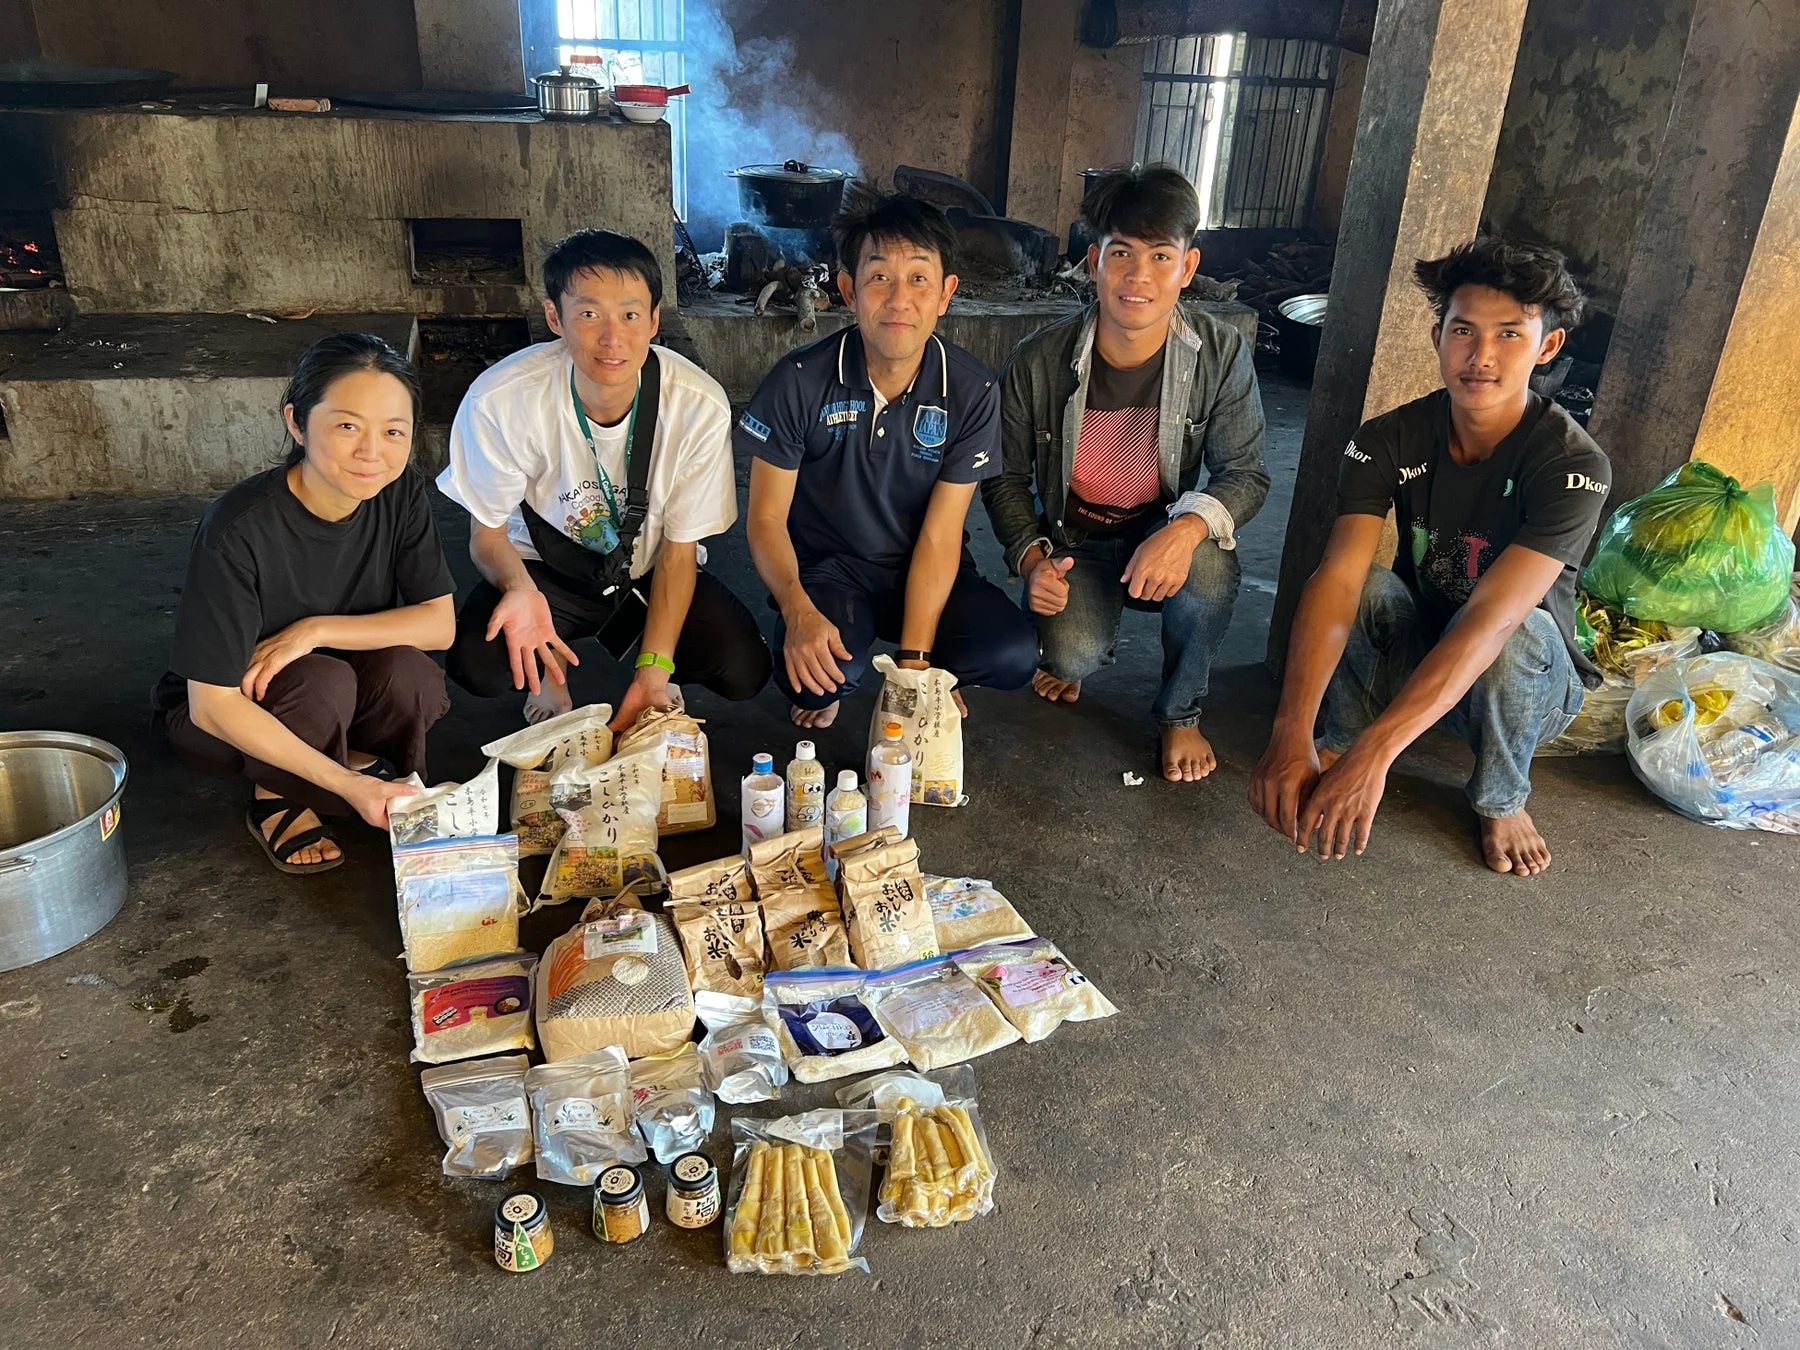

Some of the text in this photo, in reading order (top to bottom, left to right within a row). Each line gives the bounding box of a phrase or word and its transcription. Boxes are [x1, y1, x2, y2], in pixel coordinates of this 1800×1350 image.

[1344, 440, 1372, 463] Dkor
[1565, 473, 1608, 495] Dkor
[913, 682, 928, 768] こひかり
[599, 771, 619, 844] こしひかり
[874, 900, 897, 932] お米
[882, 882, 907, 922] おいしい
[703, 926, 727, 960] お米
